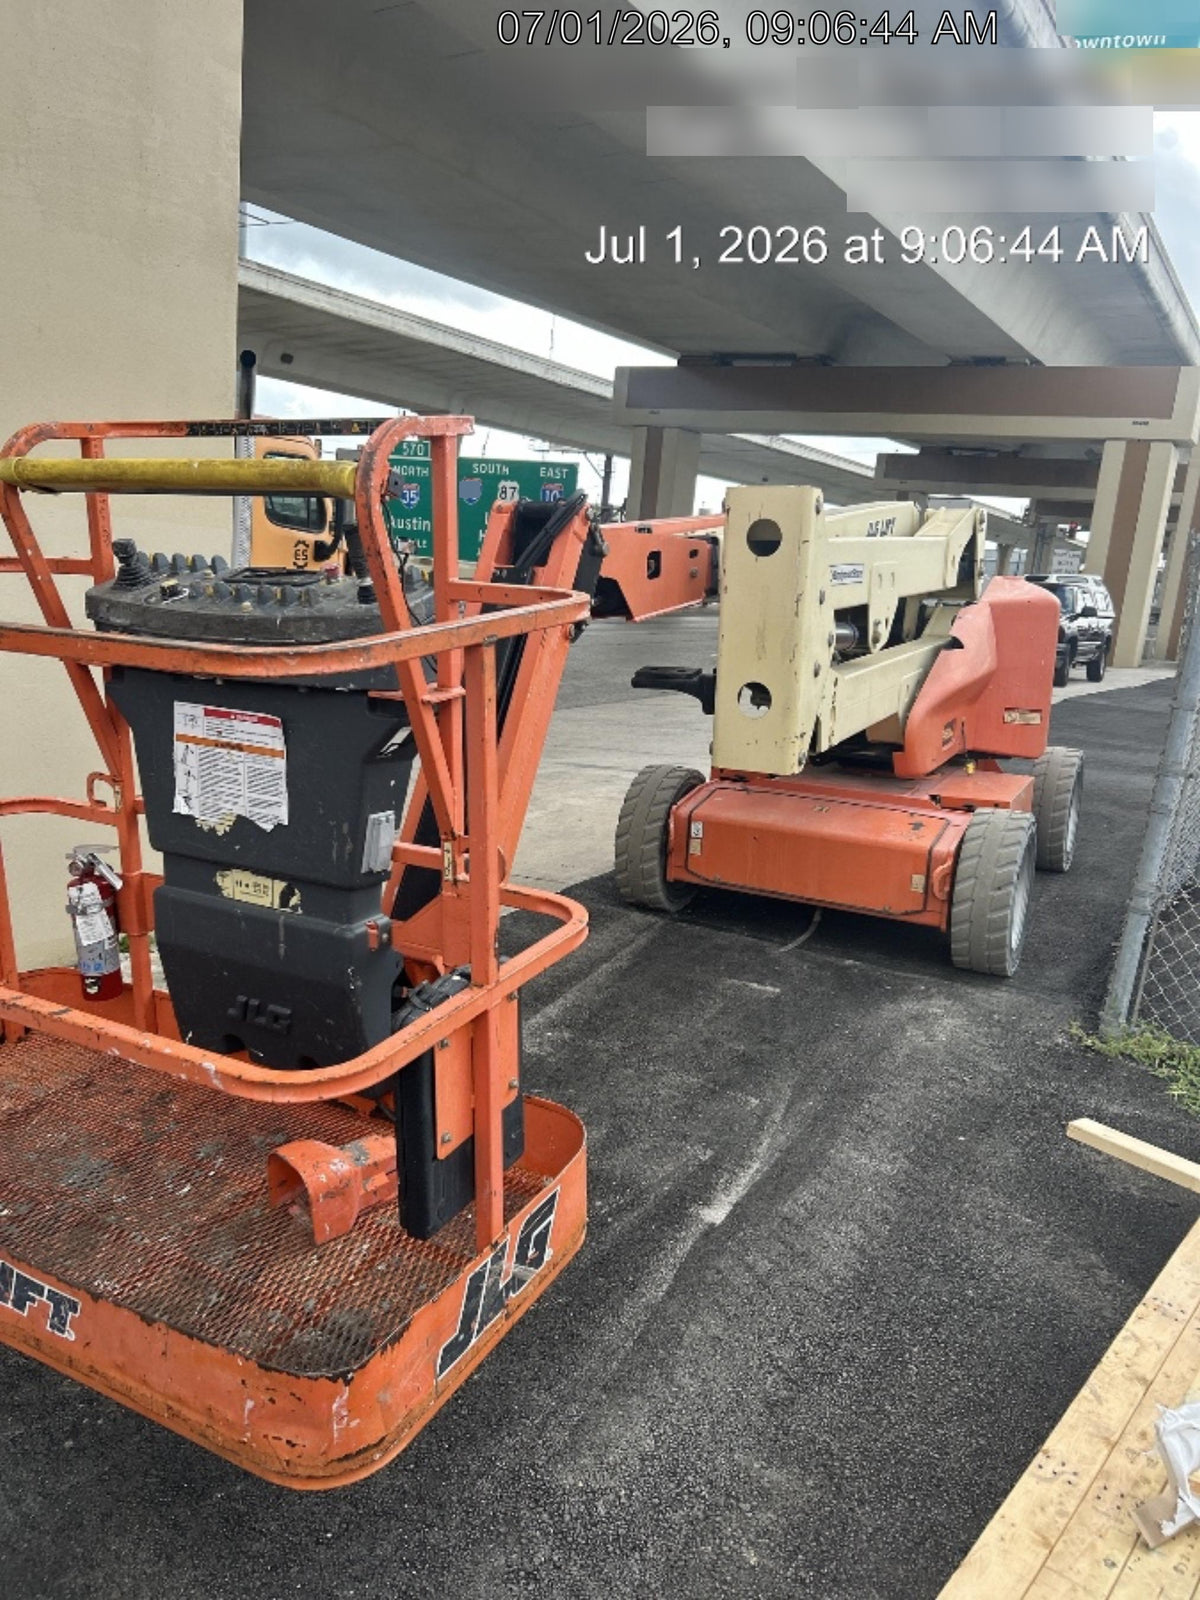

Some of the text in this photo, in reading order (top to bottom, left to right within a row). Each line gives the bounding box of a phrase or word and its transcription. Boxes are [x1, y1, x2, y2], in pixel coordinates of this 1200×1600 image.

[403, 442, 424, 456] 570
[472, 463, 509, 475] SOUTH
[540, 467, 569, 479] EAST
[402, 490, 418, 504] 35
[499, 486, 517, 500] 87
[545, 490, 560, 502] 10
[437, 1186, 560, 1381] JLG
